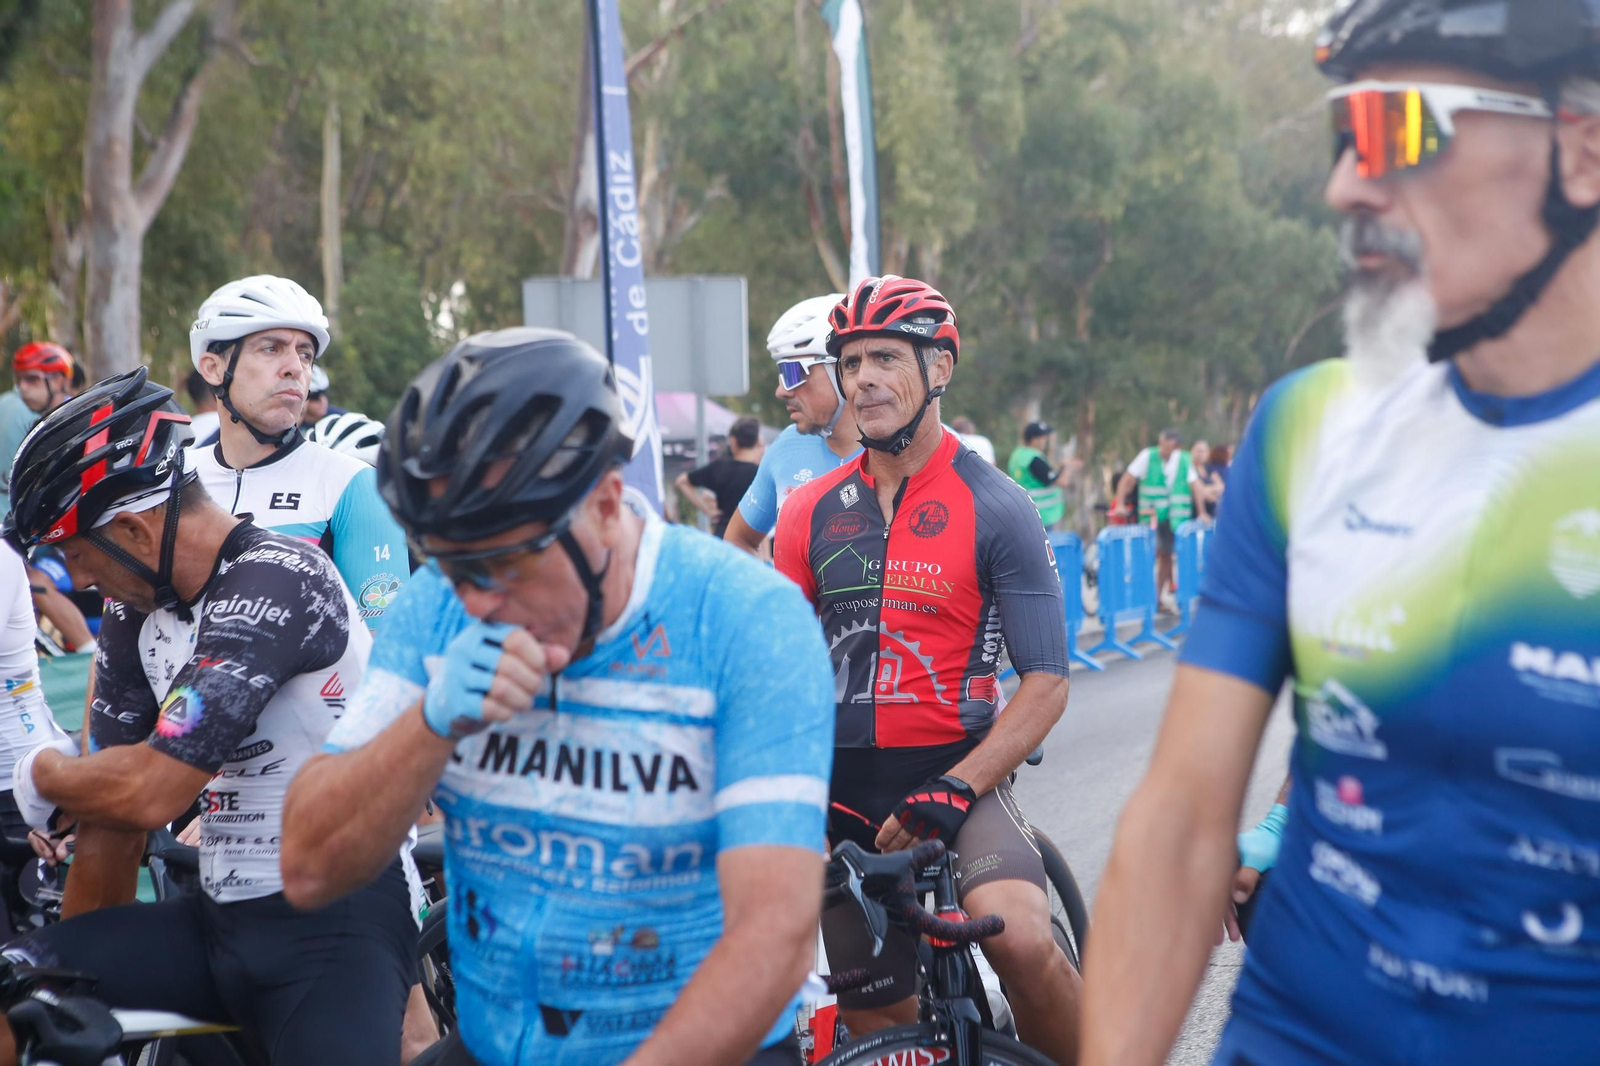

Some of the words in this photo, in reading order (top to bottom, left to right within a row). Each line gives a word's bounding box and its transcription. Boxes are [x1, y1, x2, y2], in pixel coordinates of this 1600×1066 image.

[626, 284, 649, 336] de
[269, 492, 301, 511] ES
[373, 543, 391, 562] 14
[868, 559, 941, 575] GRUPO
[478, 731, 699, 793] MANILVA
